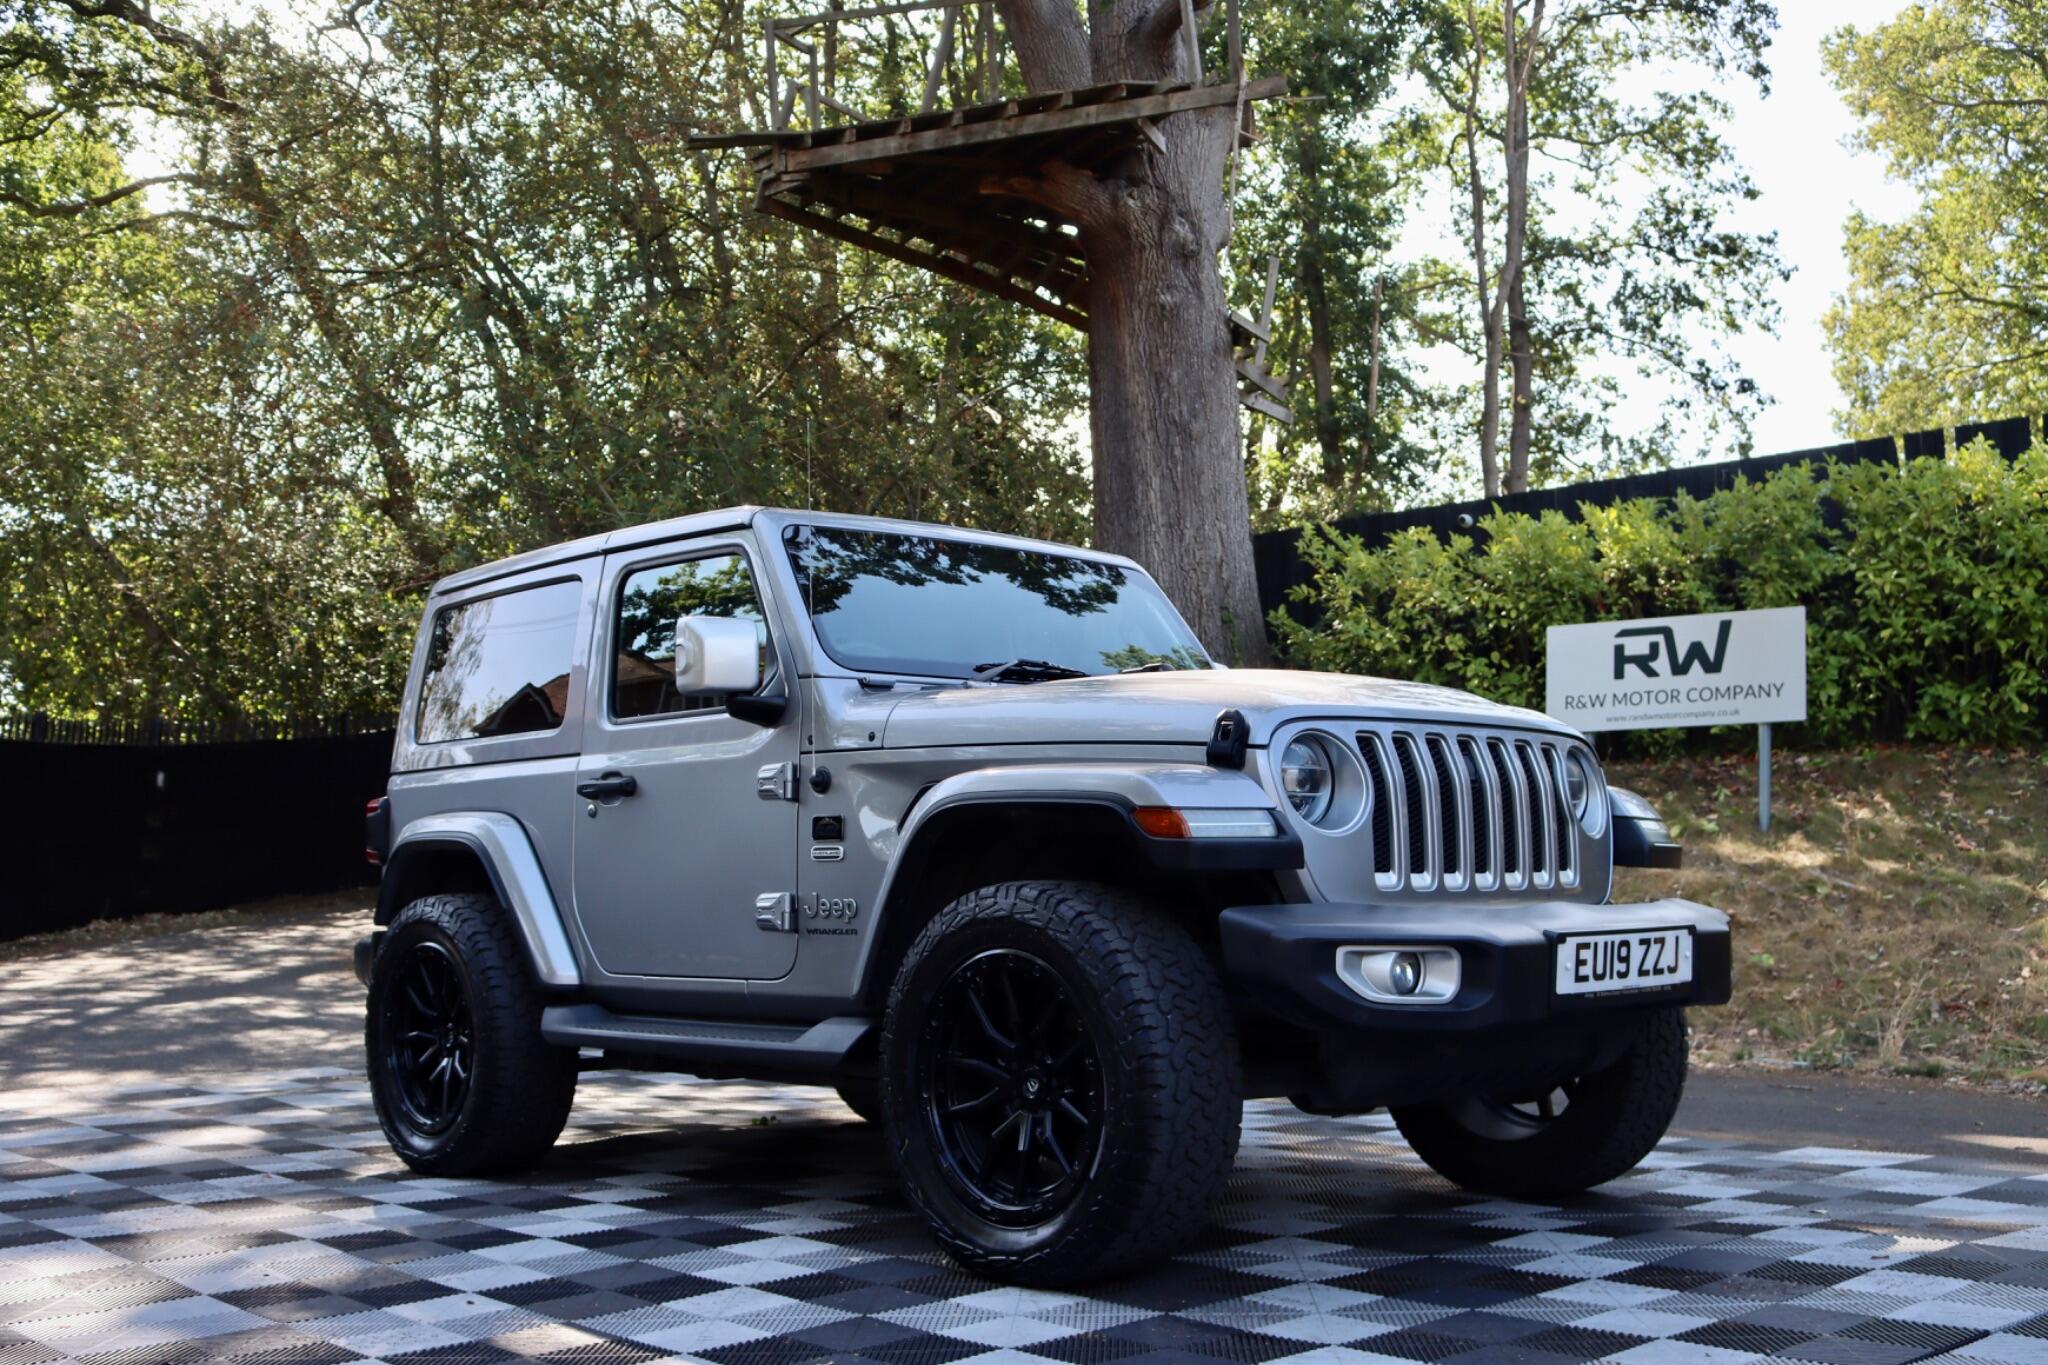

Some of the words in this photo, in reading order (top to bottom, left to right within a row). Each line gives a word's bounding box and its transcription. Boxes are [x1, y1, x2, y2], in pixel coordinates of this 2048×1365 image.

[1613, 619, 1733, 681] RW
[1564, 692, 1608, 711] R&W
[1612, 688, 1681, 708] MOTOR
[1686, 682, 1785, 704] COMPANY
[1605, 707, 1741, 724] www.randwmotorcompany.co.uk
[803, 891, 858, 925] Jeep
[805, 927, 858, 936] WRANGLER
[1574, 939, 1631, 984] EU19
[1637, 935, 1680, 978] ZZJ
